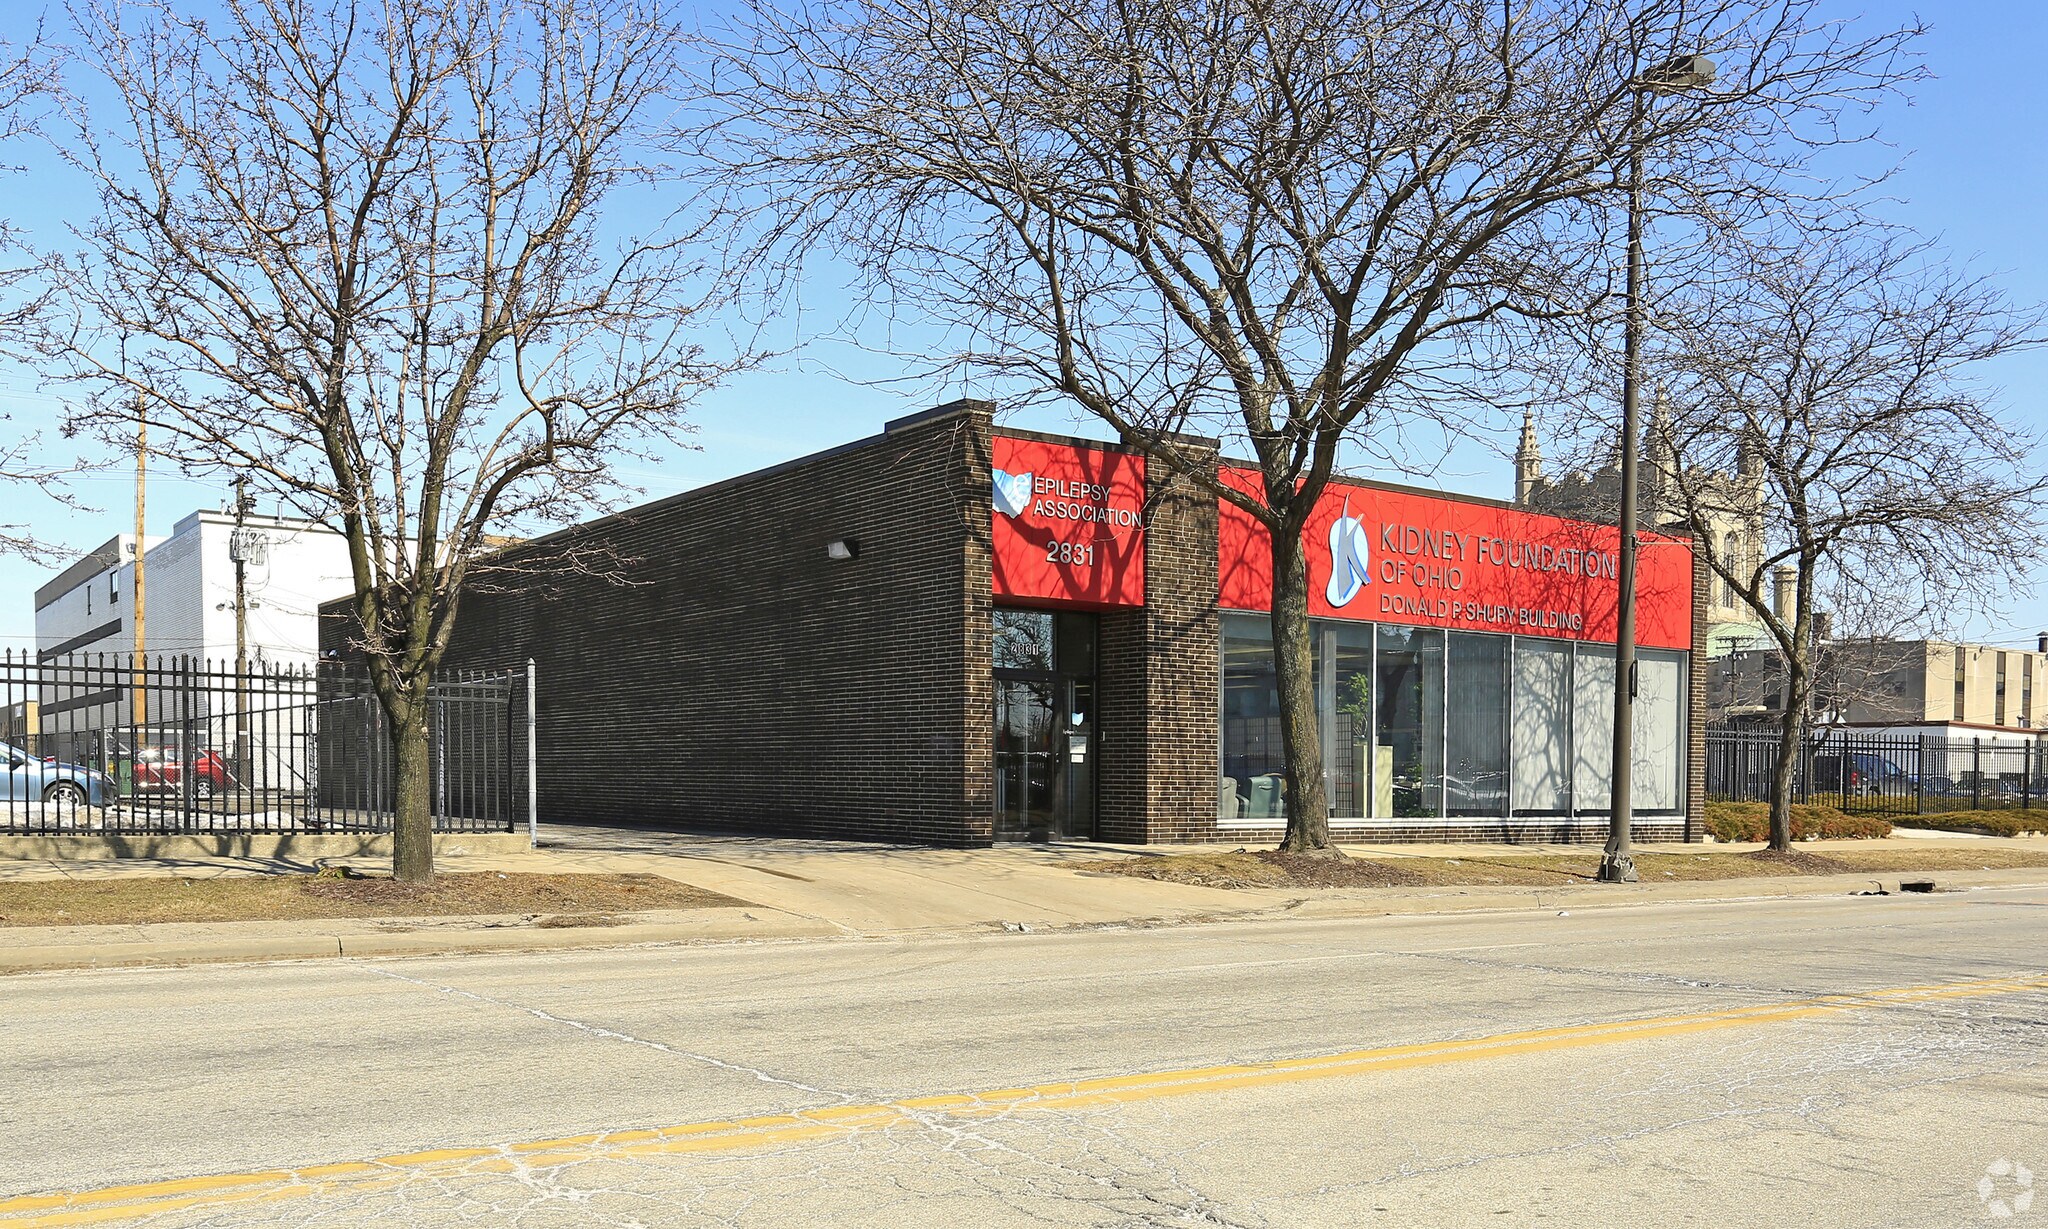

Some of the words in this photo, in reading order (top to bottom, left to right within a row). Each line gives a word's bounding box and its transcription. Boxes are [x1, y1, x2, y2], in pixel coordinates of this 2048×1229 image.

[1034, 477, 1111, 502] EPILEPSY
[1033, 499, 1142, 528] ASSOCIATION
[1046, 540, 1095, 566] 2831
[1381, 522, 1470, 561] KIDNEY
[1477, 535, 1616, 580] FOUNDATION
[1381, 558, 1407, 584] OF
[1412, 562, 1464, 591] OHIO
[1381, 593, 1449, 619] DONALD
[1465, 602, 1516, 624] SHURY
[1518, 607, 1583, 632] BUILDING
